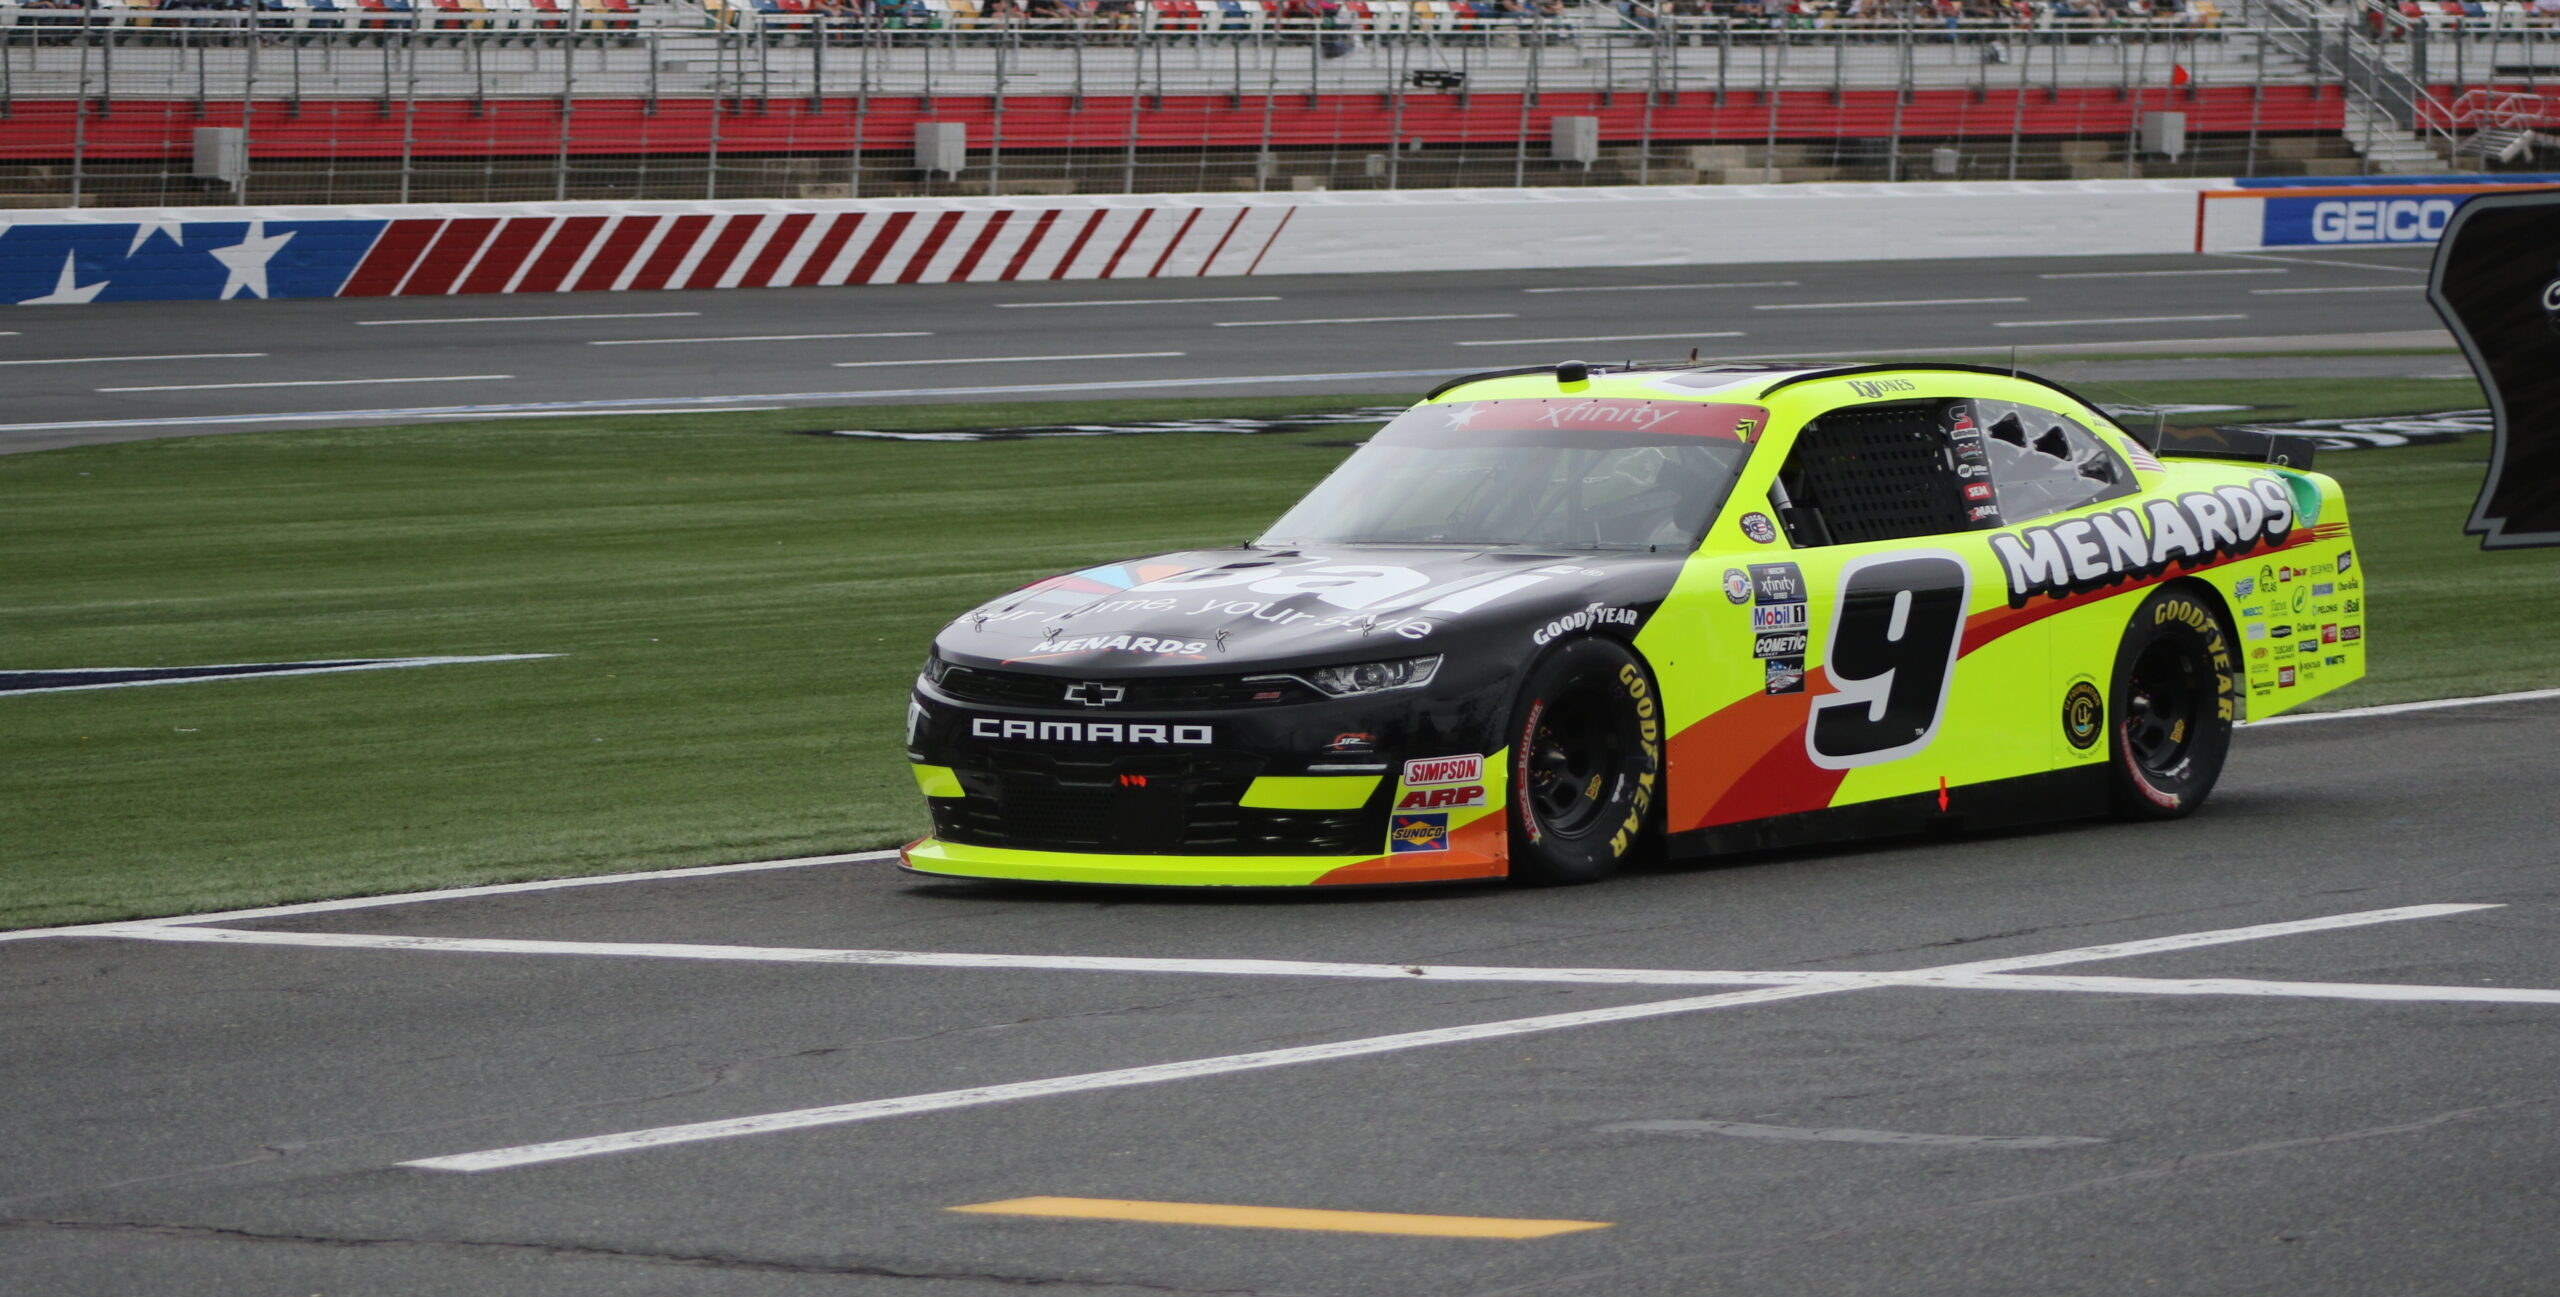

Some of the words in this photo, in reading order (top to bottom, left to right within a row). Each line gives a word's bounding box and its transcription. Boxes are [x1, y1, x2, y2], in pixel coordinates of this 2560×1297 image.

[2312, 200, 2455, 242] GEICO
[1537, 400, 1679, 430] xfinity
[1968, 486, 1989, 497] SEM
[1991, 480, 2293, 600] MENARDS
[1761, 576, 1795, 596] xfinity
[1533, 603, 1637, 646] GOODYEAR
[1755, 605, 1790, 626] Mobil
[1030, 635, 1207, 655] MENARDS
[1756, 635, 1806, 653] COMETIC
[1808, 551, 1971, 766] 9
[2155, 600, 2233, 722] GOODYEAR
[973, 718, 1212, 744] CAMARO
[1518, 704, 1541, 769] REMEMBER
[1410, 760, 1477, 782] SIMPSON
[1610, 663, 1658, 857] GOODYEAR
[1397, 786, 1484, 808] ARP
[1393, 826, 1445, 840] SUNOCO
